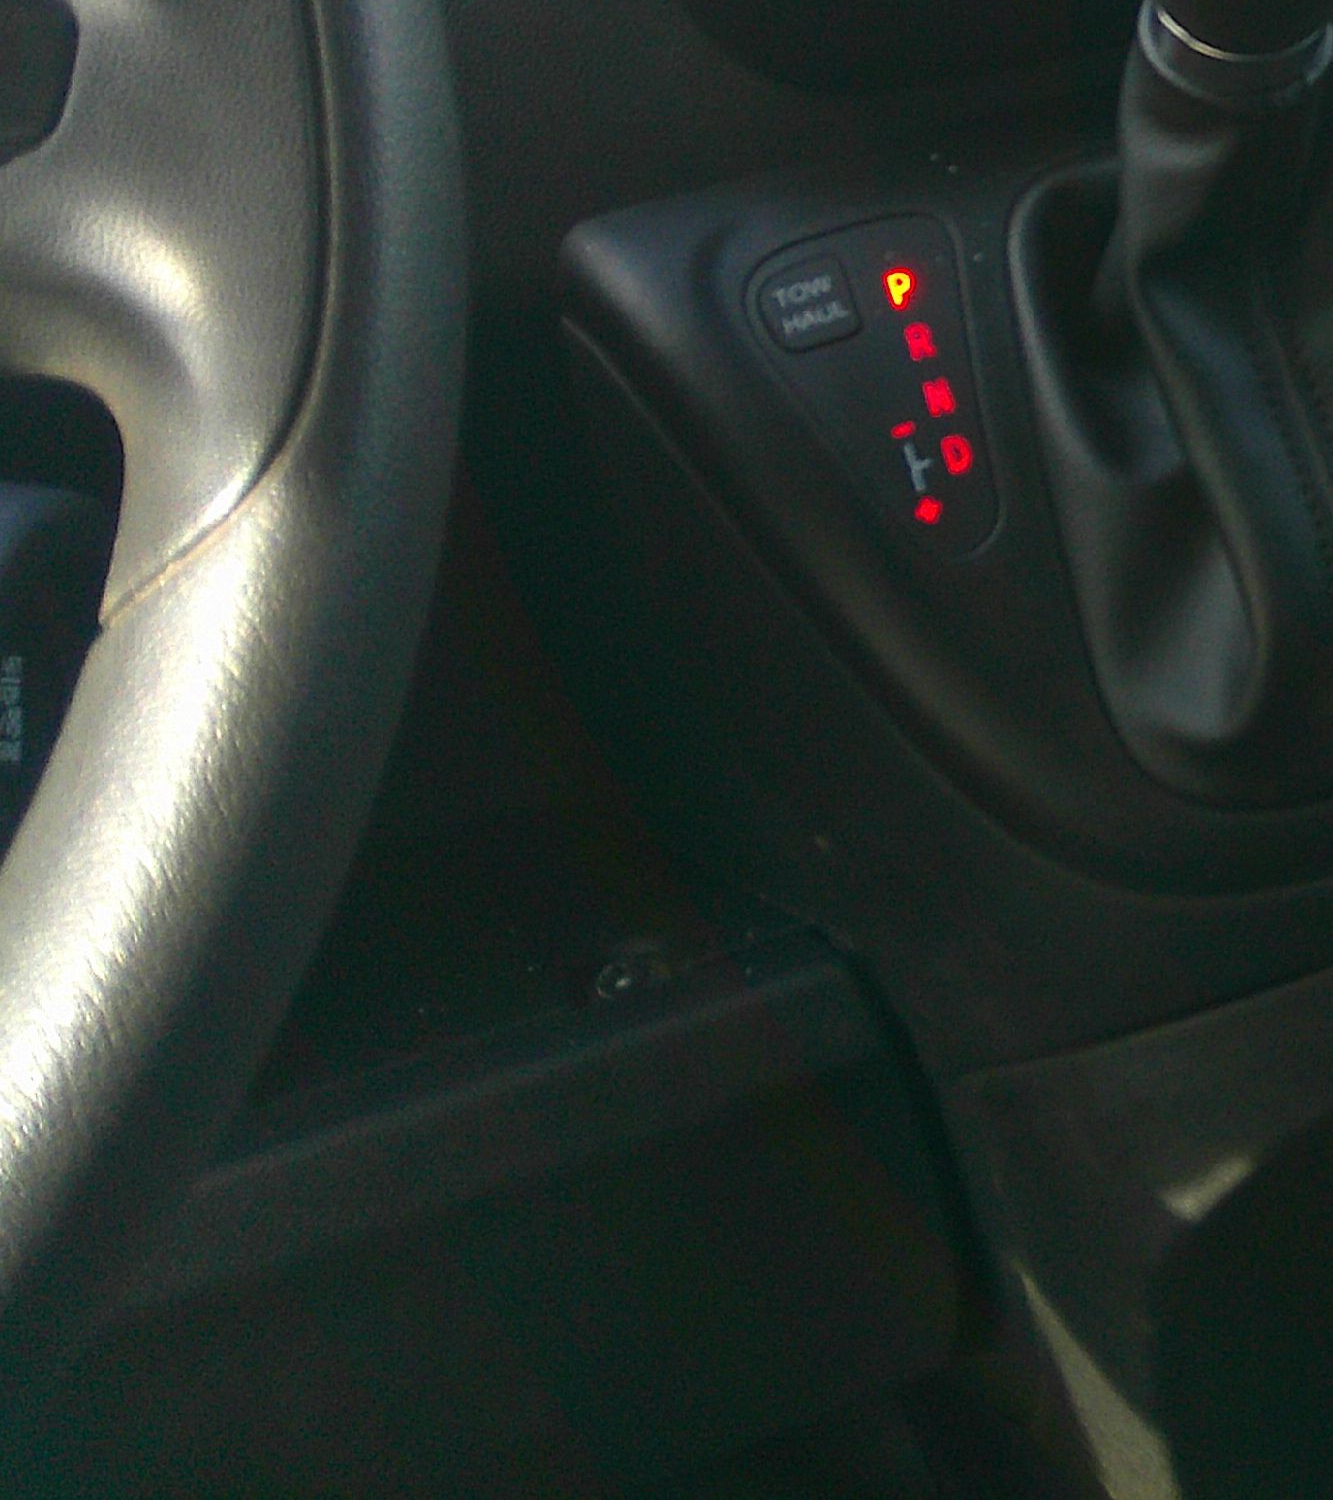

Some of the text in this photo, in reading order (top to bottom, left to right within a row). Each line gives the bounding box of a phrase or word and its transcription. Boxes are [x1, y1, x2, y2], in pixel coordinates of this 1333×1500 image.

[771, 274, 833, 308] TOW
[883, 267, 916, 310] P
[780, 301, 850, 335] HAUL
[904, 322, 937, 361] R
[941, 433, 974, 475] D
